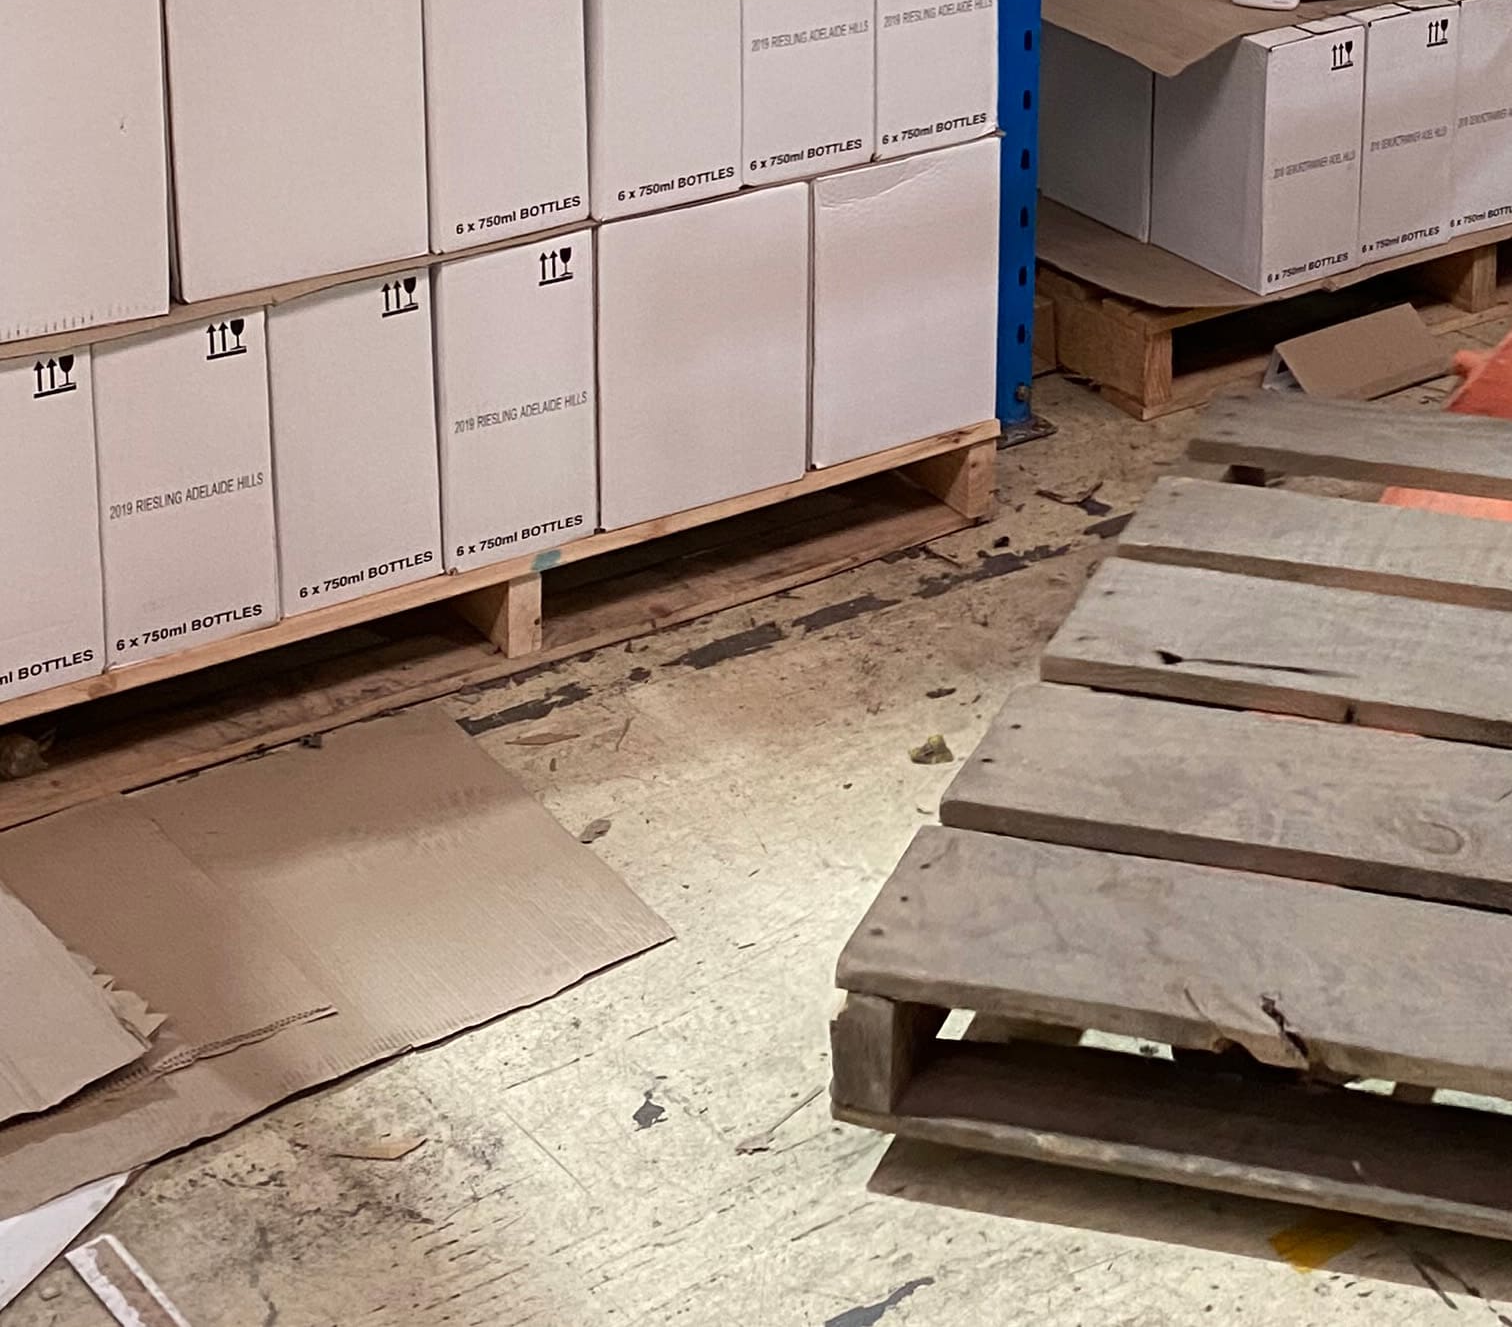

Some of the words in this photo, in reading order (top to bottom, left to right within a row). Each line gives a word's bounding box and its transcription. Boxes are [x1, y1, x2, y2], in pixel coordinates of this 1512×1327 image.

[771, 32, 807, 48] RIESLING
[809, 23, 846, 42] ADELAIDE
[849, 20, 869, 34] HILLS
[882, 133, 889, 145] 6
[891, 133, 899, 144] x
[901, 124, 933, 142] 750ml
[936, 112, 987, 133] BOTTLES
[749, 160, 757, 171] 6
[759, 159, 767, 170] x
[770, 149, 804, 167] 750ml
[807, 139, 862, 159] BOTTLES
[617, 189, 625, 202] 6
[628, 189, 636, 200] x
[639, 179, 675, 198] 750ml
[677, 166, 735, 190] BOTTLES
[456, 223, 464, 234] 6
[467, 223, 475, 233] x
[478, 211, 517, 230] 750ml
[520, 195, 581, 219] BOTTLES
[1401, 225, 1440, 243] BOTTLES
[1308, 252, 1349, 271] BOTTLES
[454, 417, 475, 434] 2019
[477, 408, 517, 429] RIESLING
[520, 397, 562, 418] ADELAIDE
[565, 390, 587, 409] HILLS
[109, 502, 133, 520] 2019
[136, 490, 183, 513] RIESLING
[185, 478, 234, 502] ADELAIDE
[237, 472, 264, 490] HILLS
[456, 545, 465, 557] 6
[468, 544, 477, 555] x
[480, 531, 518, 552] 750ml
[521, 514, 584, 540] BOTTLES
[299, 586, 308, 599] 6
[311, 585, 320, 596] x
[324, 570, 365, 593] 750ml
[368, 550, 433, 579] BOTTLES
[116, 638, 125, 652] 6
[129, 637, 139, 648] x
[143, 623, 188, 645] 750ml
[191, 604, 263, 631] BOTTLES
[18, 649, 94, 680] BOTTLES
